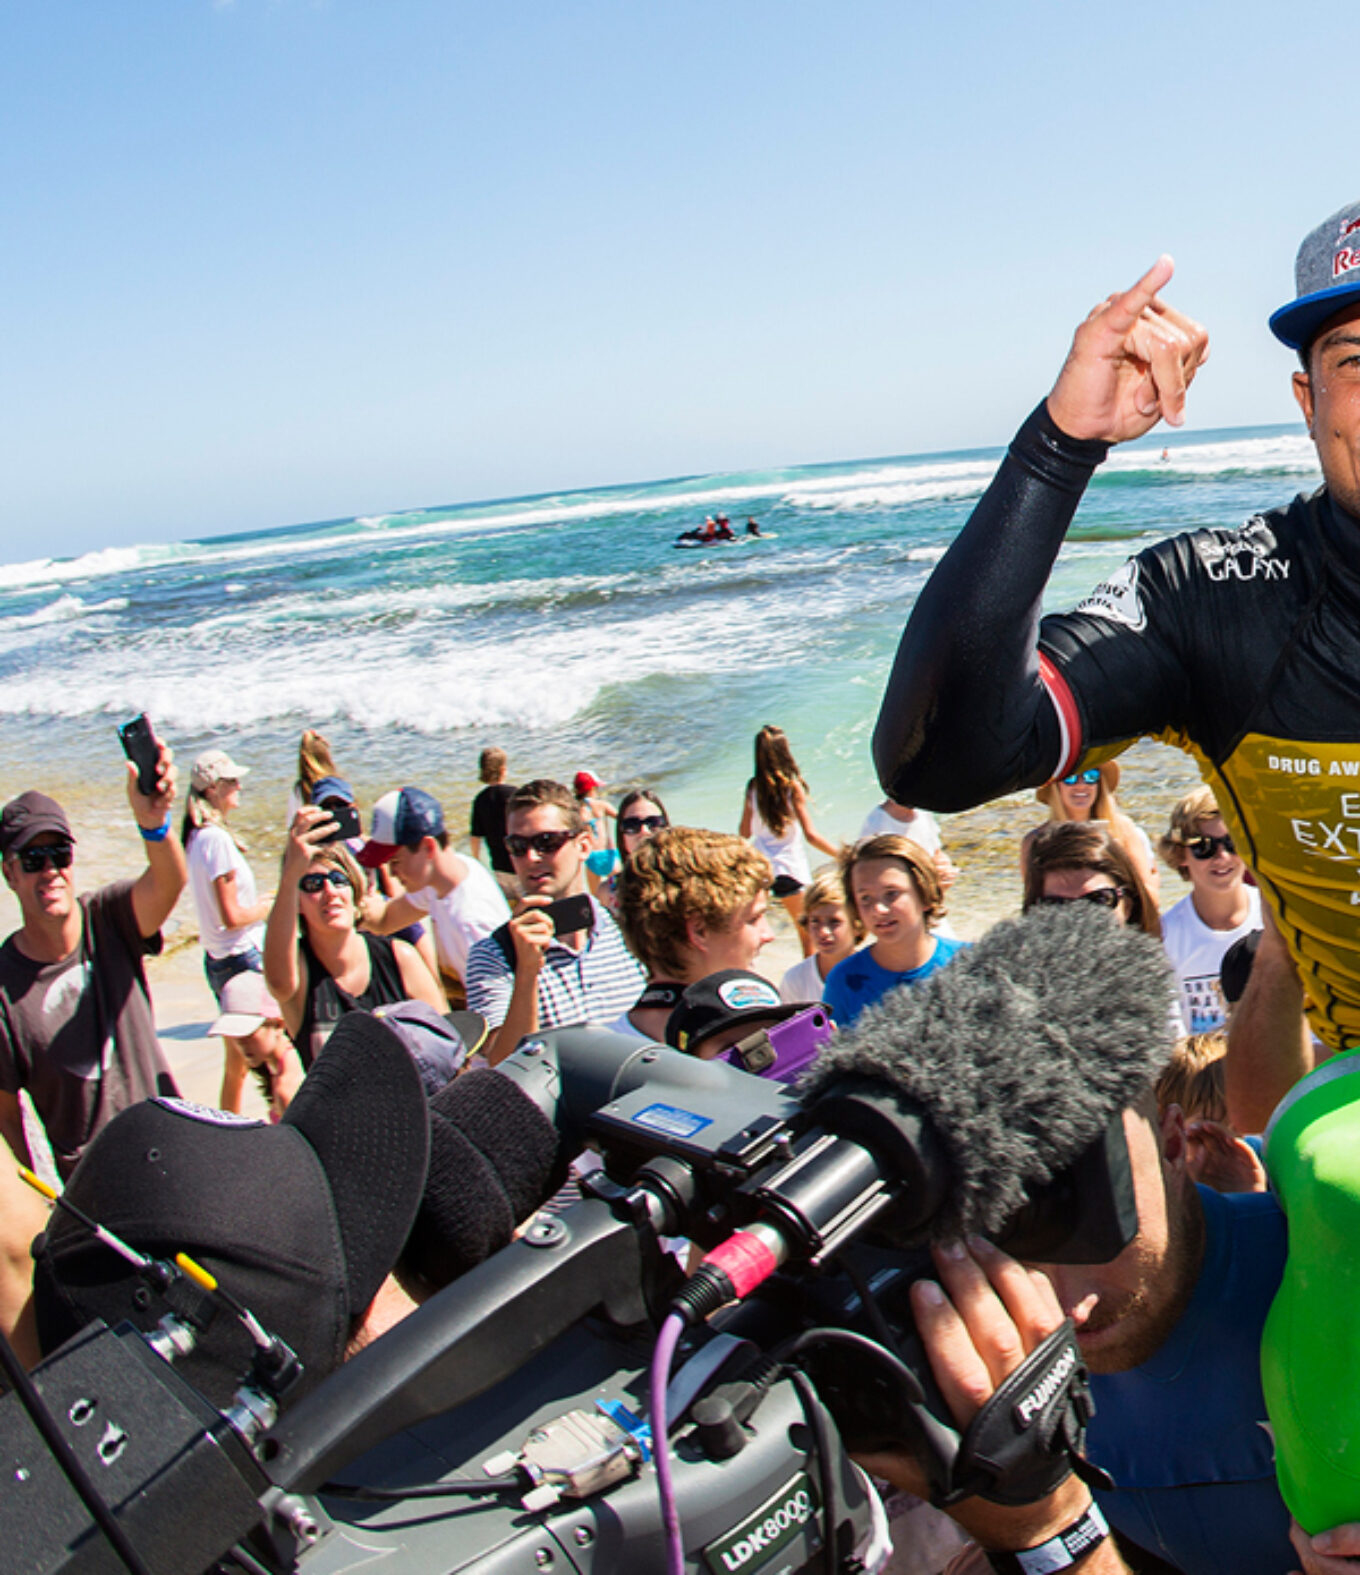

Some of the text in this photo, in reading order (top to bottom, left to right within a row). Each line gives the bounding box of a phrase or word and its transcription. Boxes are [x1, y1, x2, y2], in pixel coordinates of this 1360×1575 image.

[1268, 755, 1320, 776] DRUG
[1018, 1345, 1076, 1421] FUJINON
[720, 1489, 812, 1572] LDK8000
